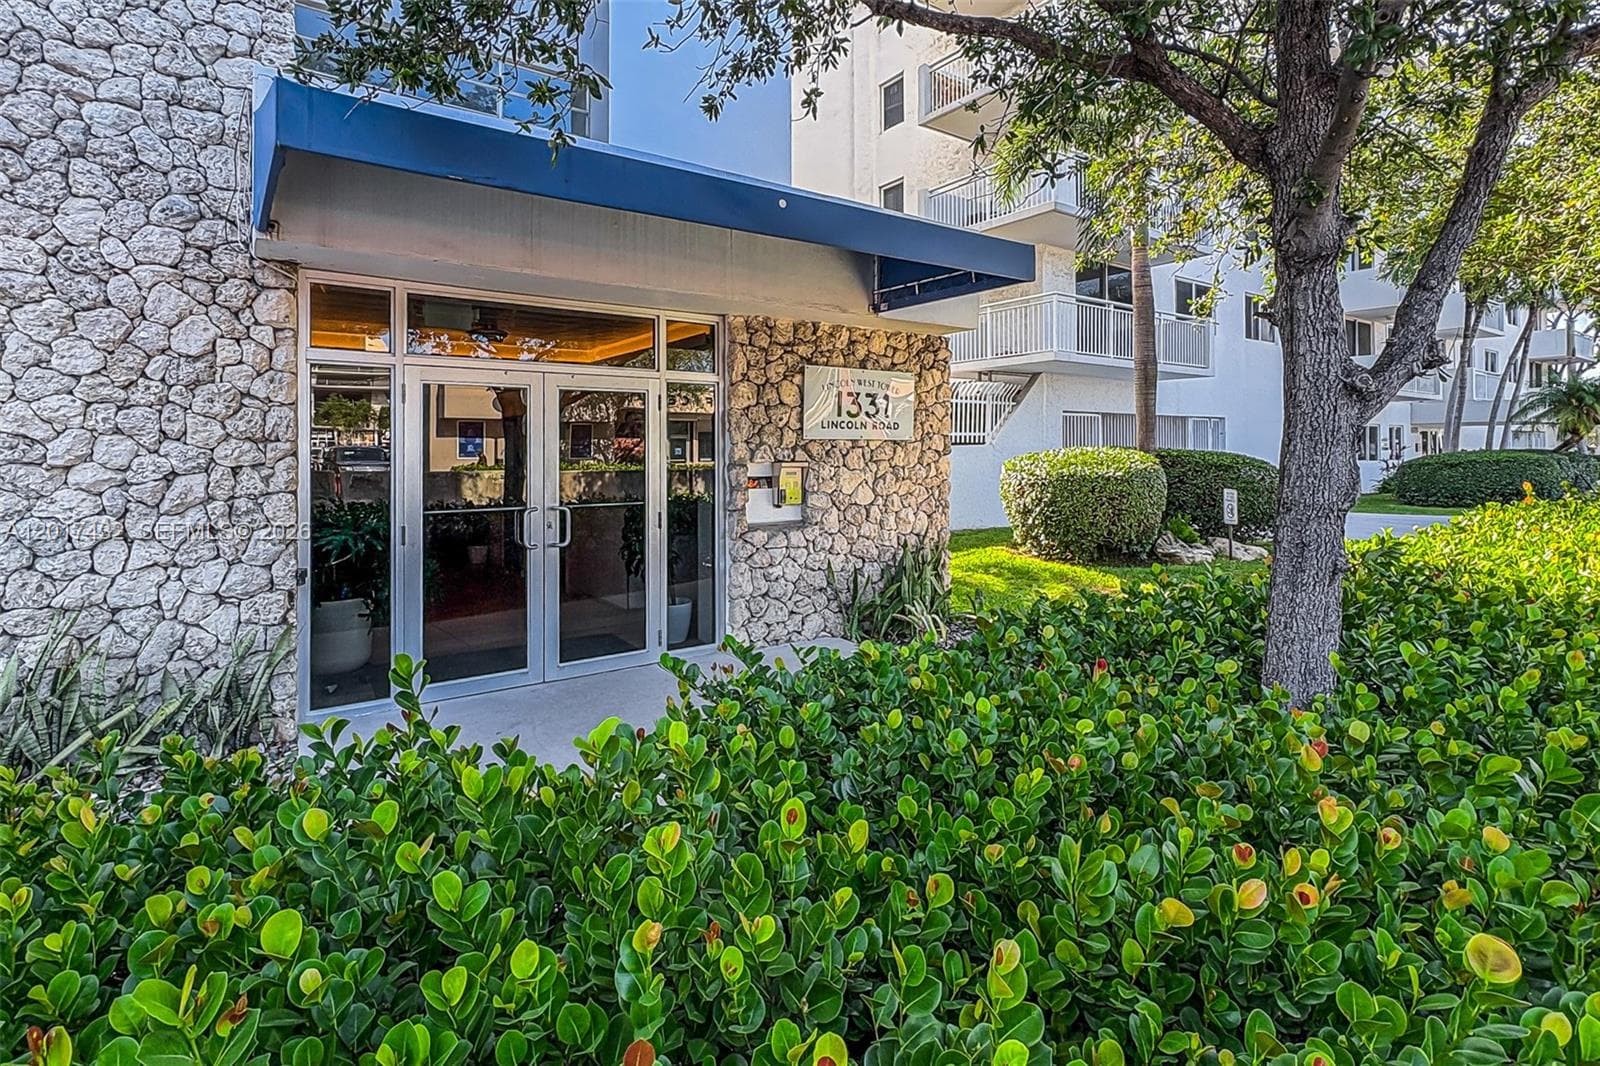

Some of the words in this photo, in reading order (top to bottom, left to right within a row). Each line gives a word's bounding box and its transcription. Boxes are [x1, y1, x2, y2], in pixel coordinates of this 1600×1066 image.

[835, 391, 890, 419] 1331
[821, 420, 867, 430] LINCOLN
[872, 421, 900, 431] ROAD
